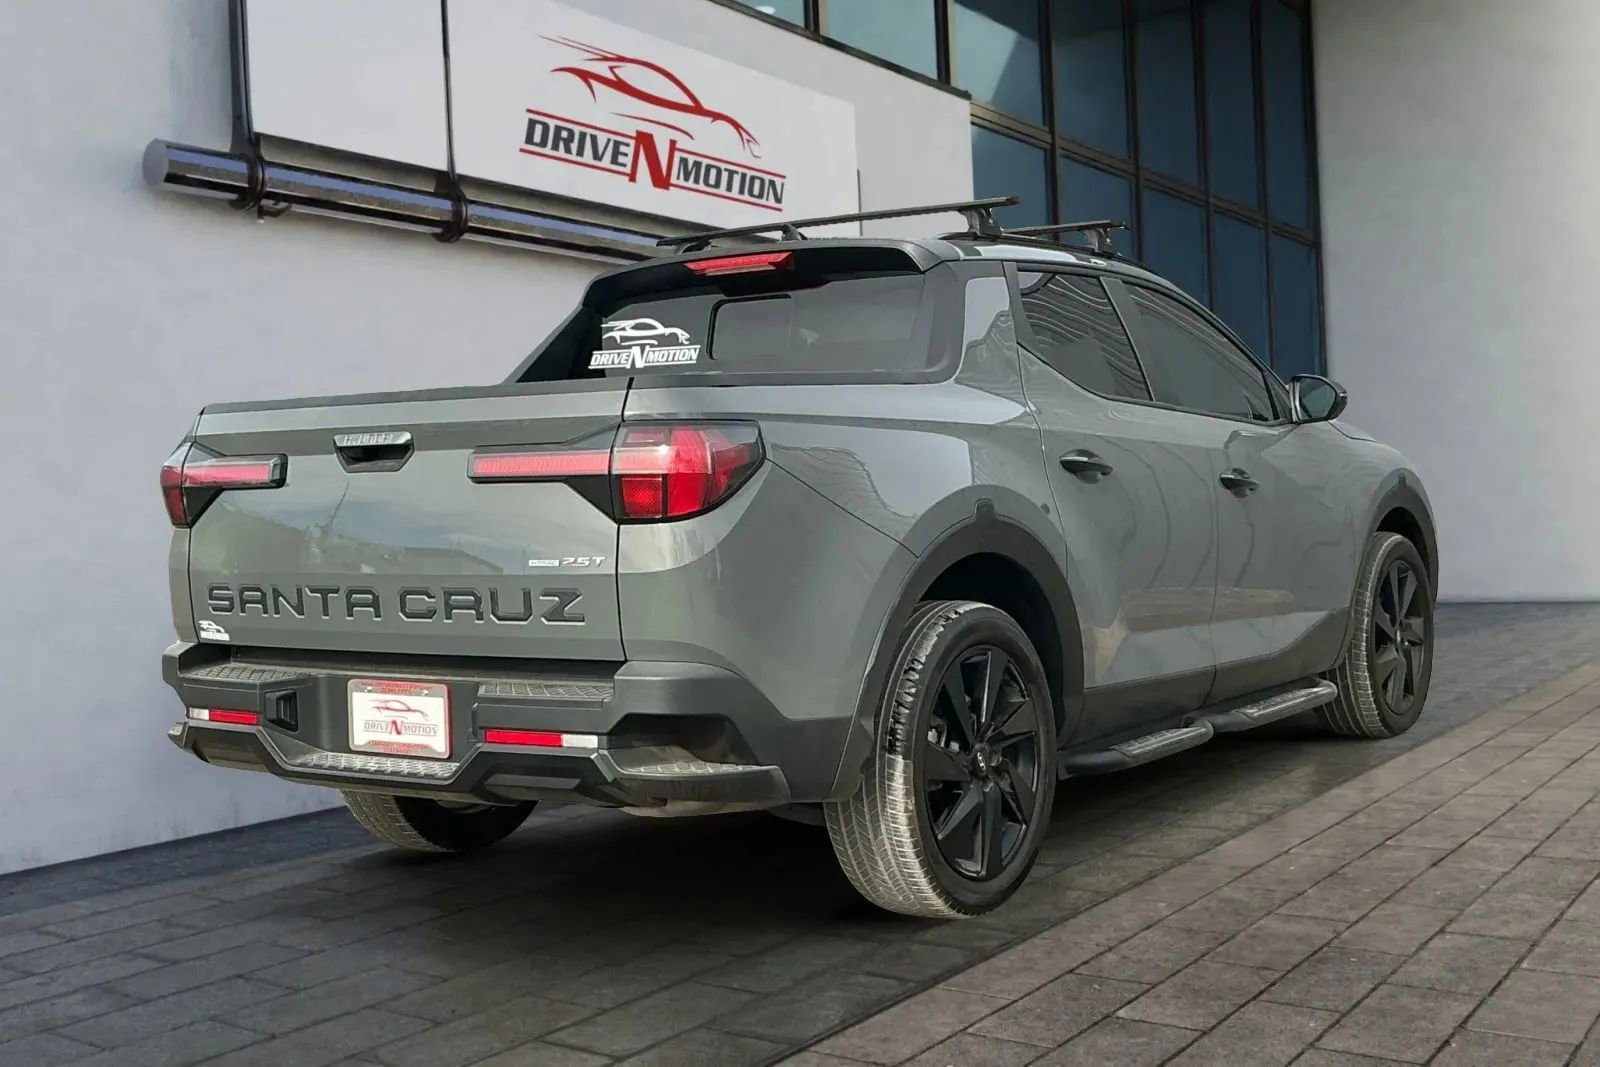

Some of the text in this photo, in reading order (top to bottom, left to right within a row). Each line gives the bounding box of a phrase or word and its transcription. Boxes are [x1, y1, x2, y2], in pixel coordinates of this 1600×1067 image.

[524, 117, 785, 204] DRIVE N MOTION
[590, 353, 630, 366] DRIVE
[646, 348, 699, 362] MOTION
[208, 584, 586, 625] SANTA CRUZ
